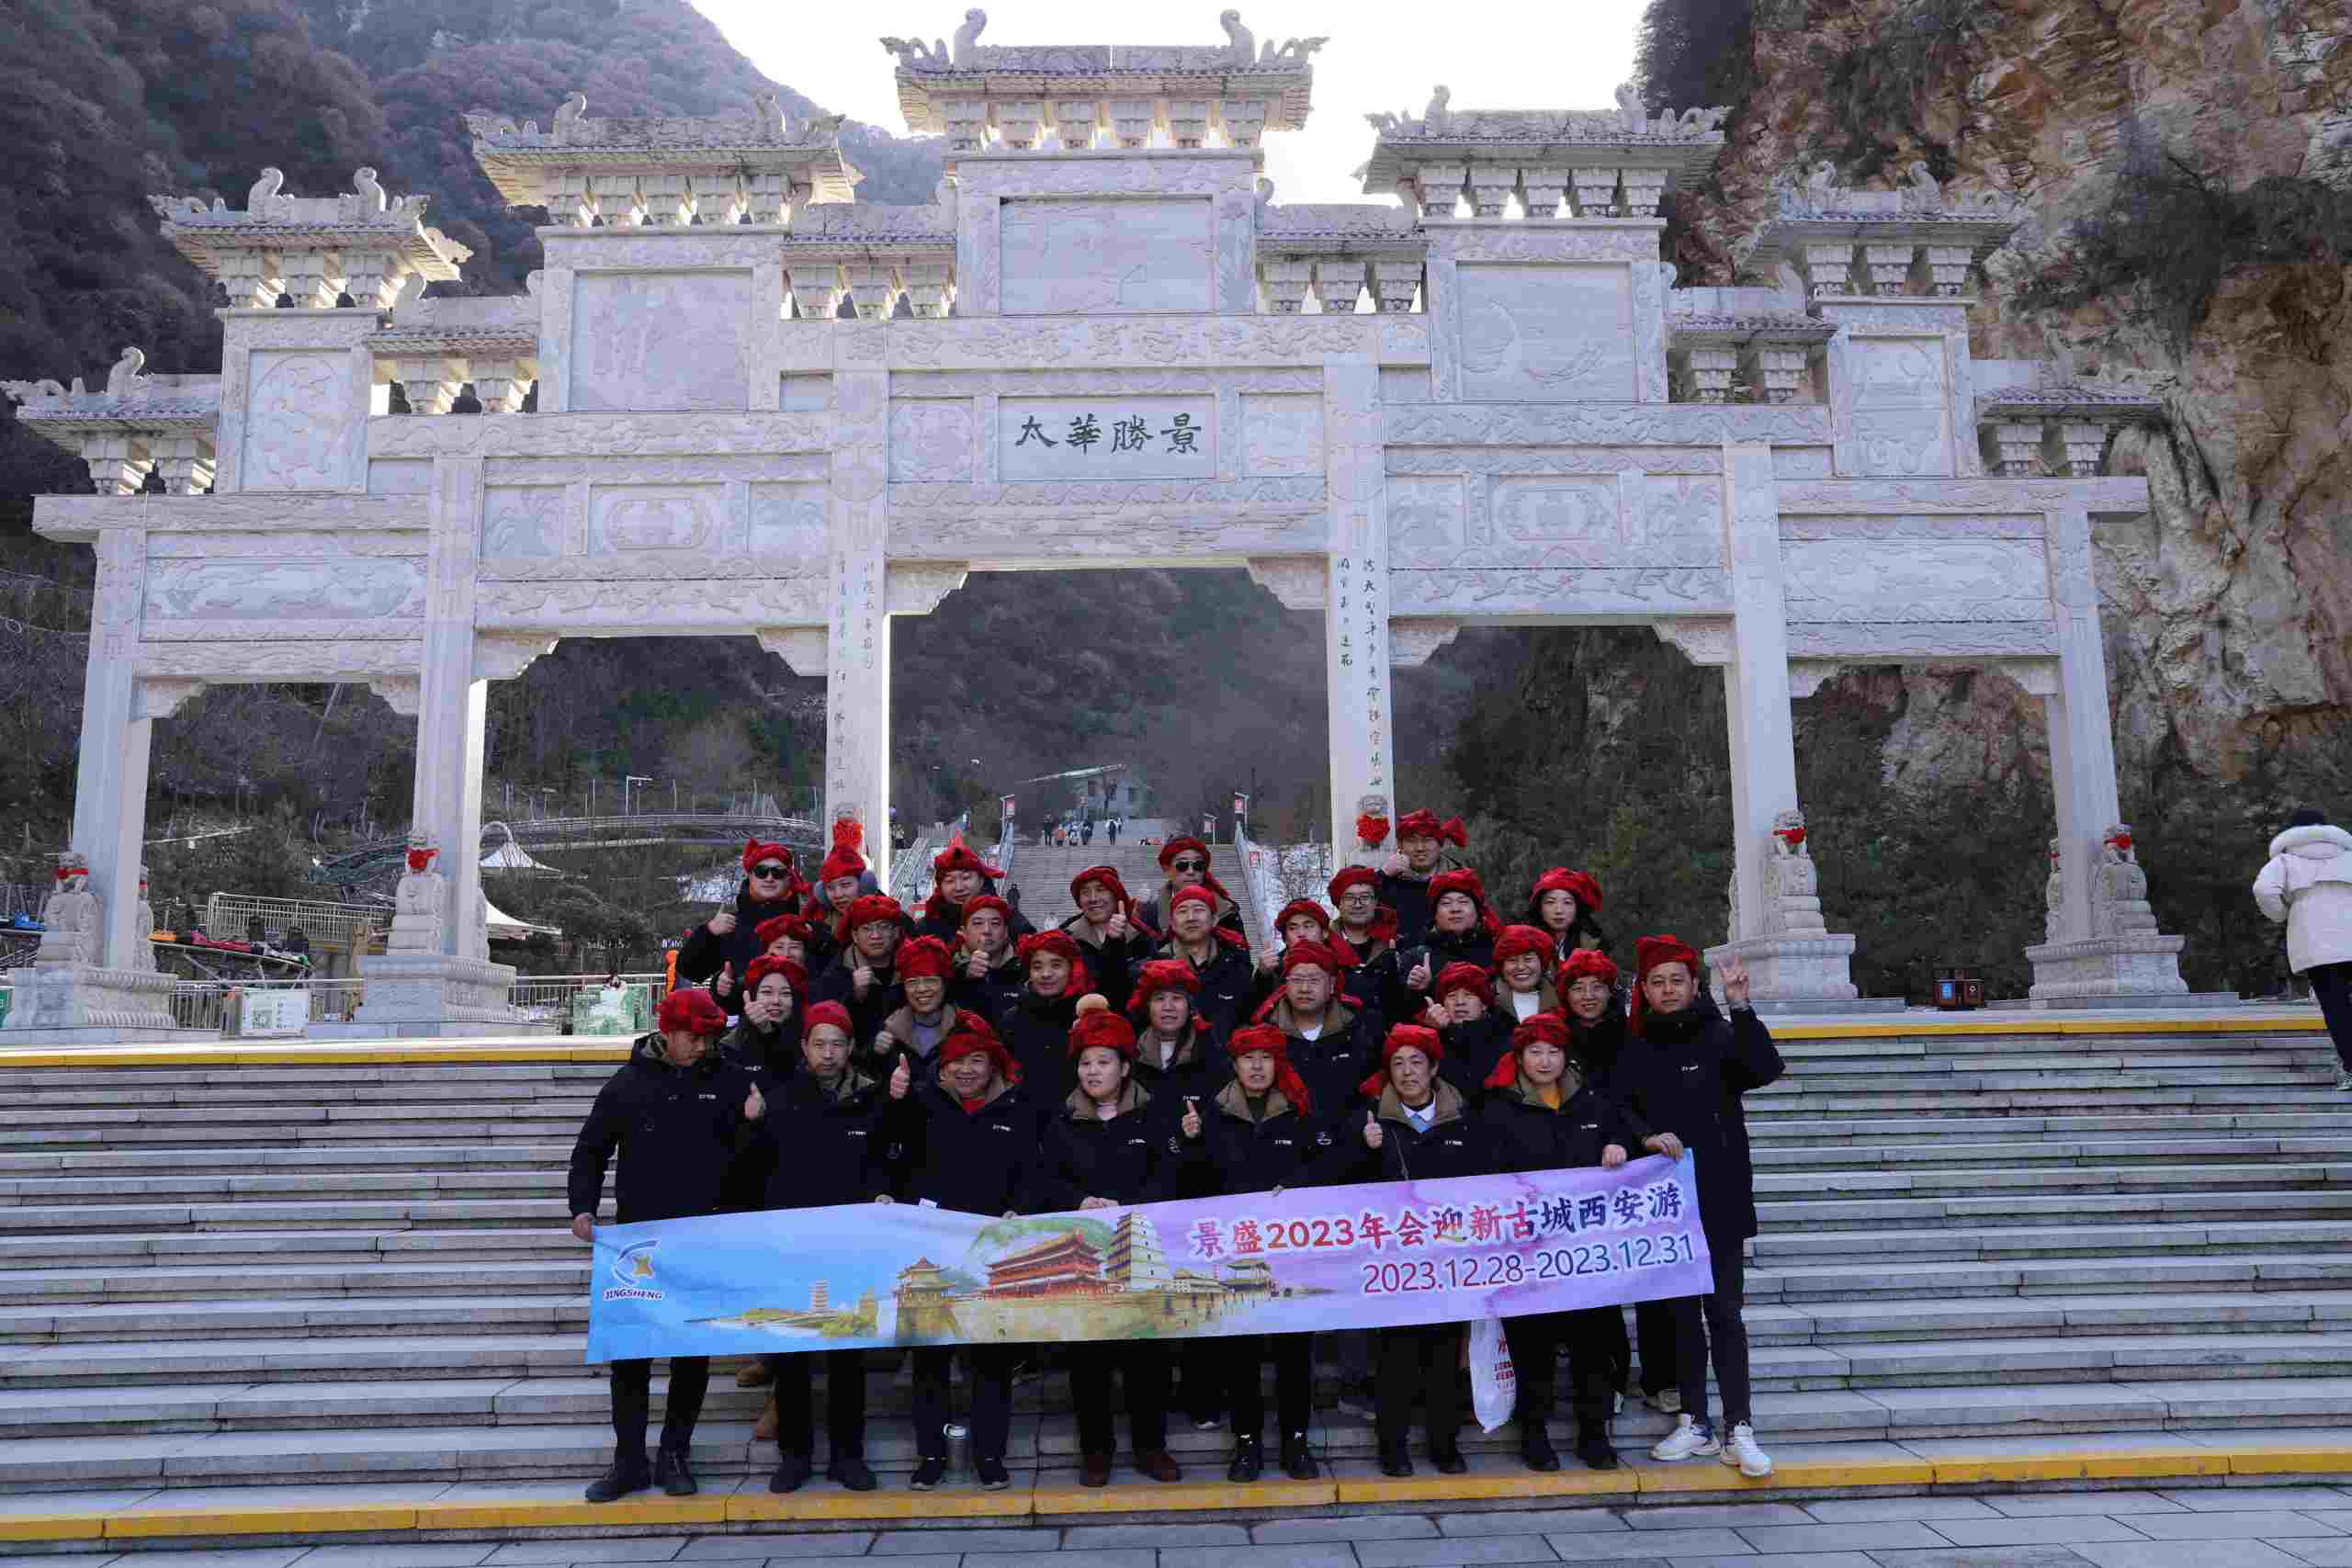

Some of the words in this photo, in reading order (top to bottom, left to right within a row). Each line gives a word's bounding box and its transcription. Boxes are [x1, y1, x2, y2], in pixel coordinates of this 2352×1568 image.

[1014, 412, 1203, 455] 太華勝景
[1192, 1182, 1683, 1258] 景盛2023年会迎新古城西安游
[1363, 1234, 1694, 1294] 2023.12.28-2023.12.31
[604, 1289, 663, 1300] JINGSHENG
